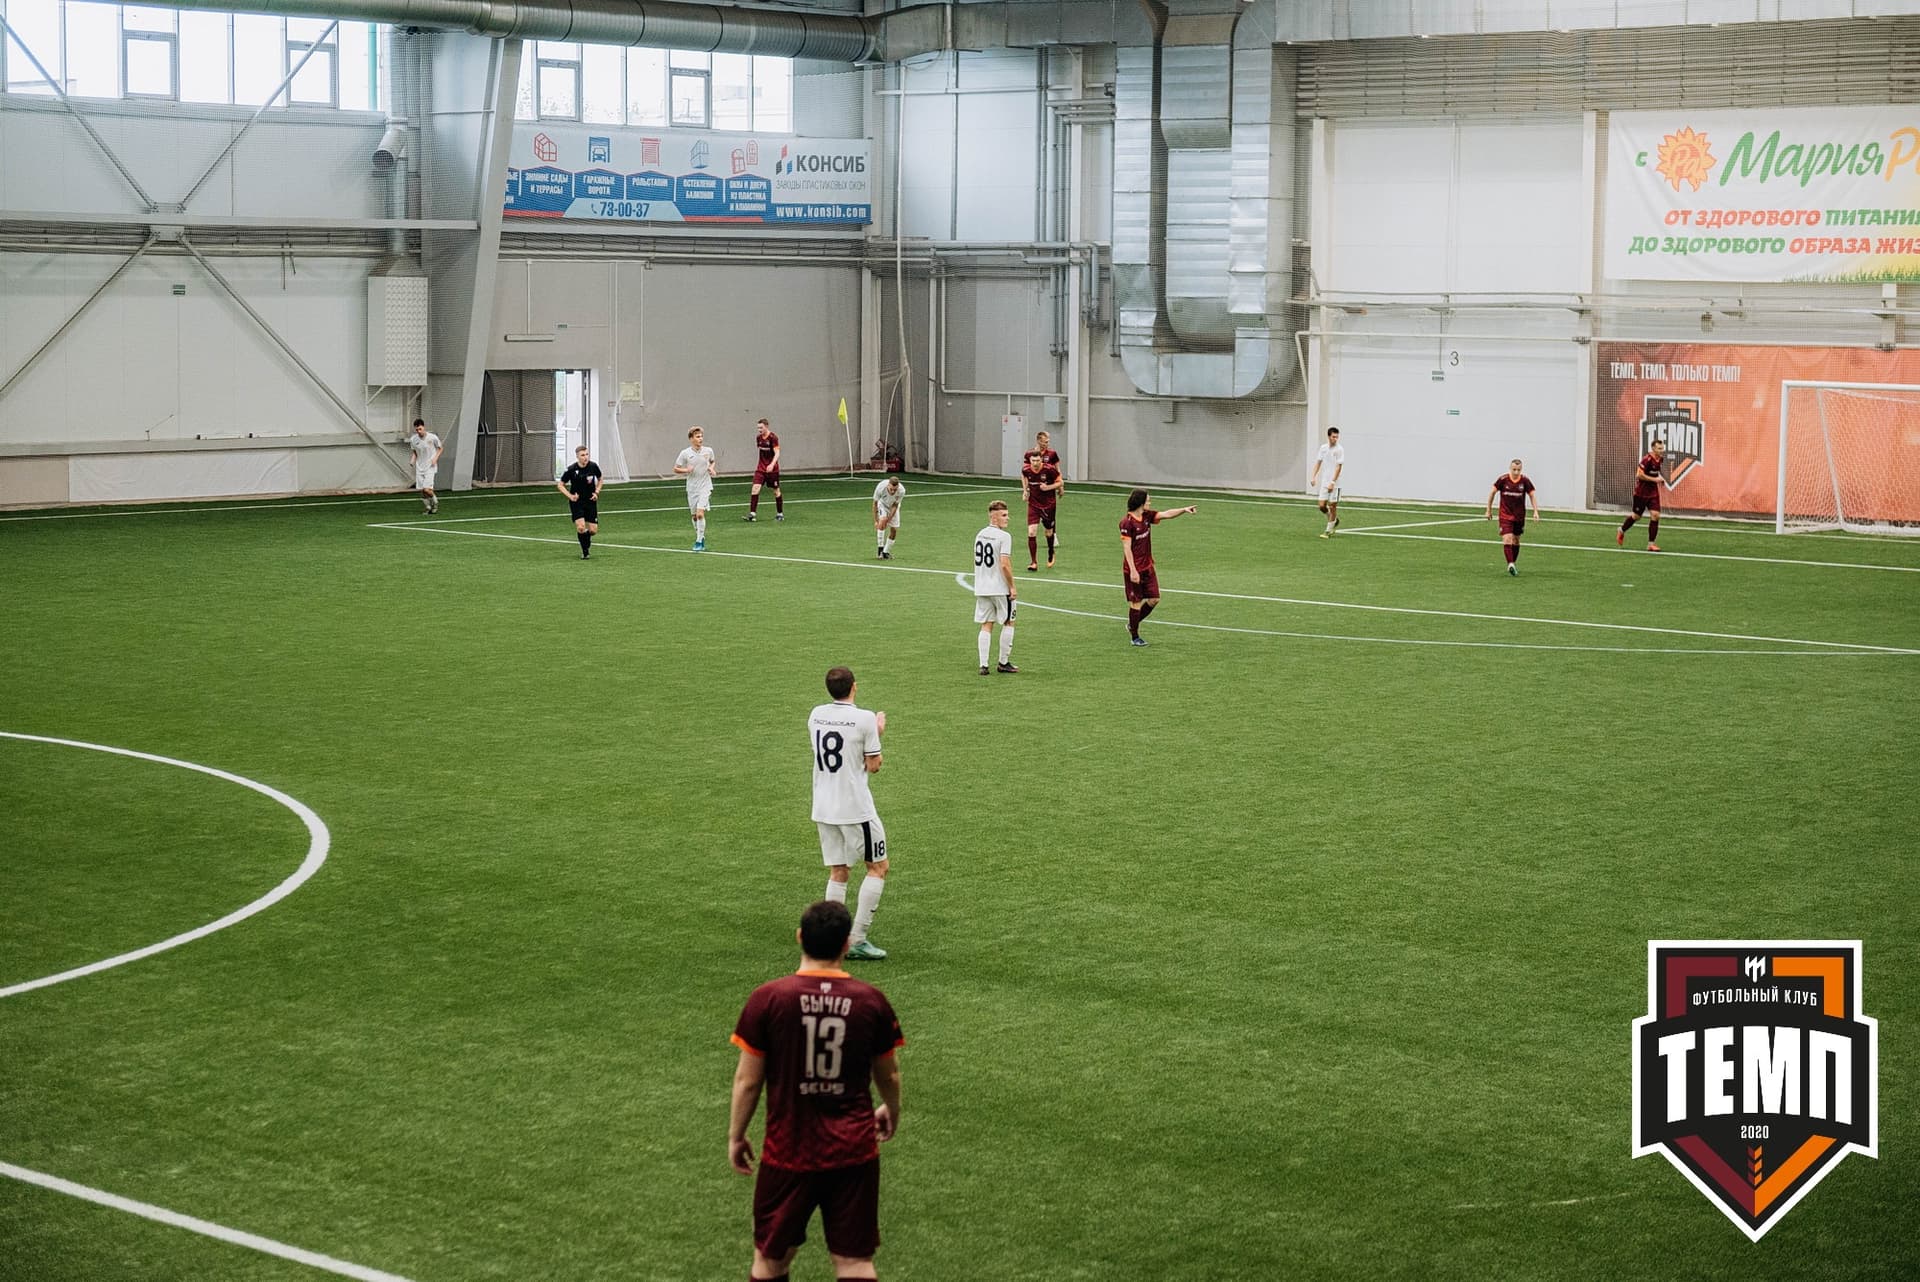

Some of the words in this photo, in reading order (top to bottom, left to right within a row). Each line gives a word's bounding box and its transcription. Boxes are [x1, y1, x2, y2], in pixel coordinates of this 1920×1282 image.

[796, 154, 865, 172] КОНСИБ
[1720, 127, 1920, 188] МарияР
[536, 185, 563, 194] ТЕРРАСЫ
[599, 201, 650, 218] 73-00-37
[776, 205, 866, 218] www.konsib.com
[1664, 210, 1693, 226] ОТ
[1696, 210, 1821, 228] ЗДОРОВОГО
[1628, 237, 1658, 255] ДО
[1662, 237, 1786, 255] ЗДОРОВОГО
[1789, 238, 1871, 254] ОБРАЗА
[1450, 350, 1459, 366] 3
[1610, 362, 1637, 381] ТЕМП,
[1640, 363, 1668, 383] ТЕМП,
[1671, 364, 1709, 381] ТОЛЬКО
[1712, 365, 1741, 383] ТЕМП!
[1646, 422, 1698, 456] ТЕМП
[975, 541, 994, 568] 98
[816, 729, 844, 773] 18
[874, 840, 885, 858] 18
[800, 994, 852, 1017] СЫЧЕВ
[802, 1016, 846, 1080] 13
